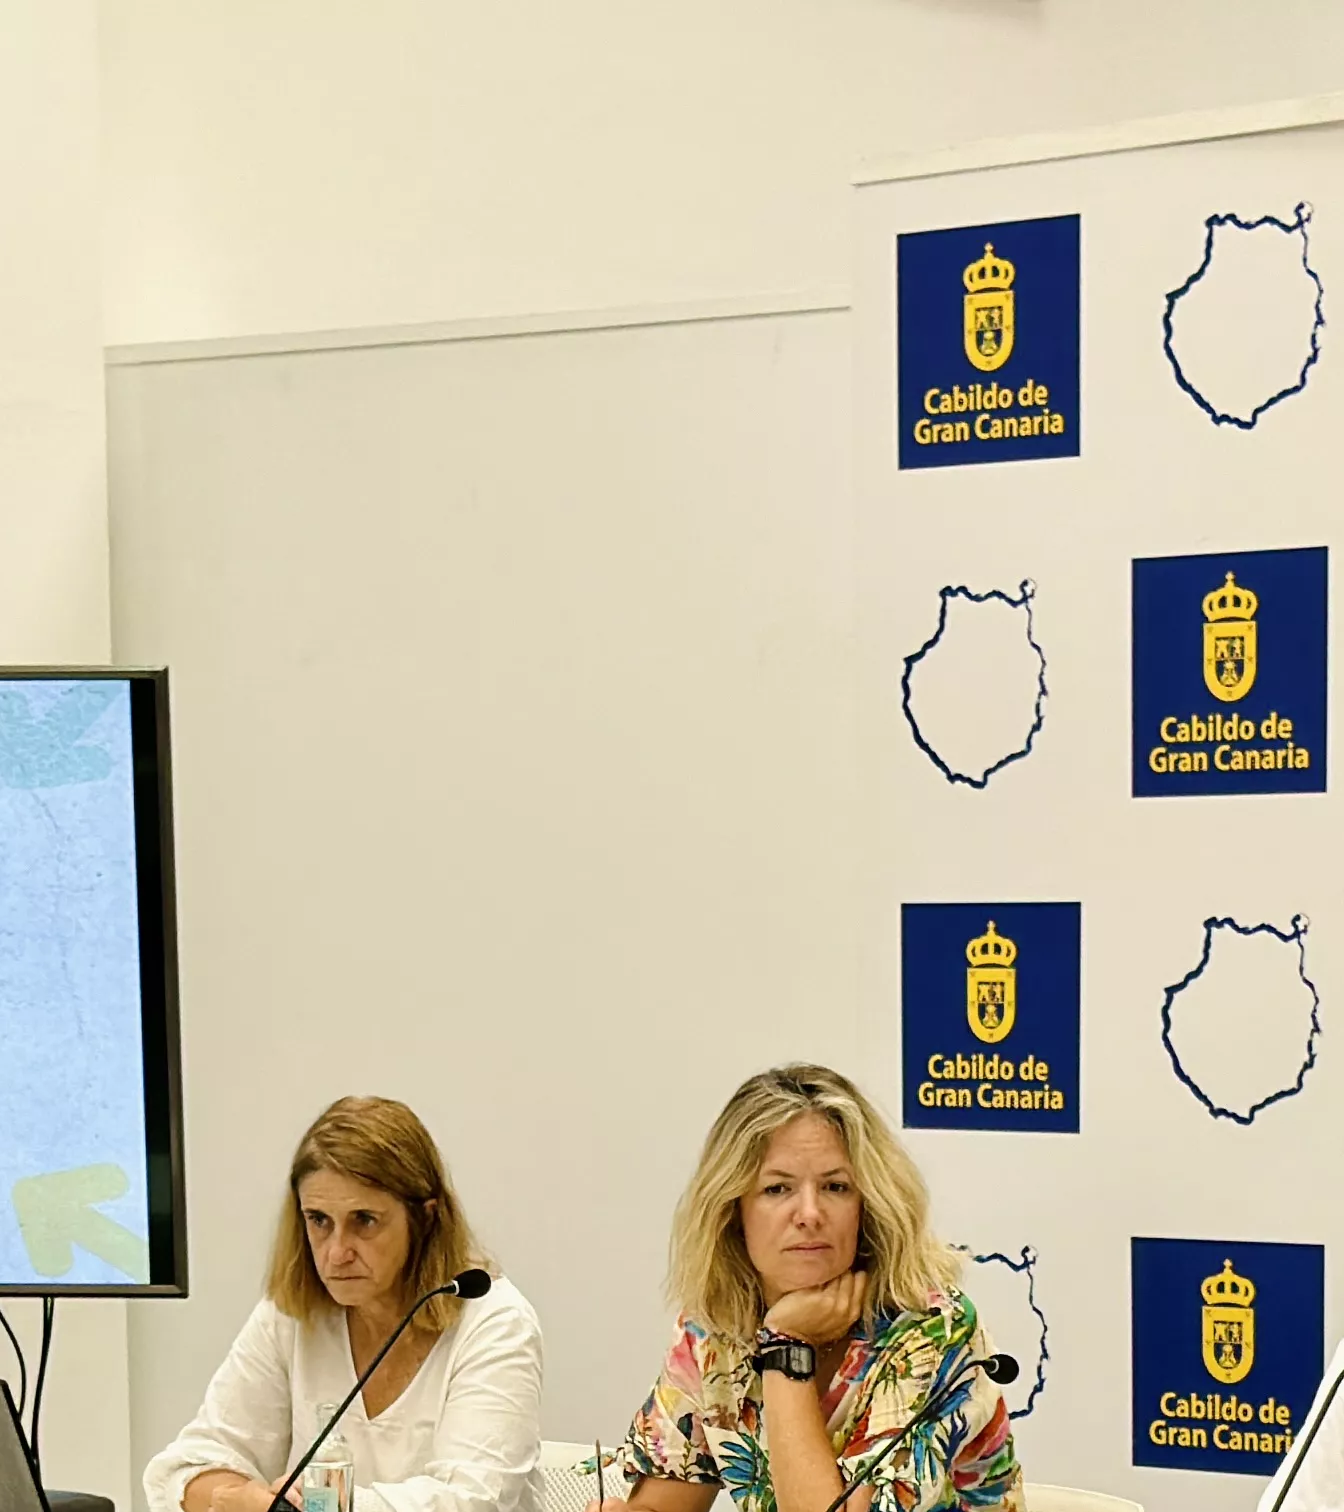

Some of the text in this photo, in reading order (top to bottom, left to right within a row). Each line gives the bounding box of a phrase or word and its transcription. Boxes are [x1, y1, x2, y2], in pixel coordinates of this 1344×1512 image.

[923, 379, 1049, 415] Cabildo de
[913, 408, 1065, 445] Gran Canaria
[1160, 711, 1293, 743] Cabildo de
[1148, 741, 1310, 773] Gran Canaria
[927, 1053, 1049, 1082] Cabildo de
[918, 1081, 1064, 1110] Gran Canaria
[1159, 1391, 1292, 1425] Cabildo de
[1149, 1419, 1293, 1454] Gran Canari
